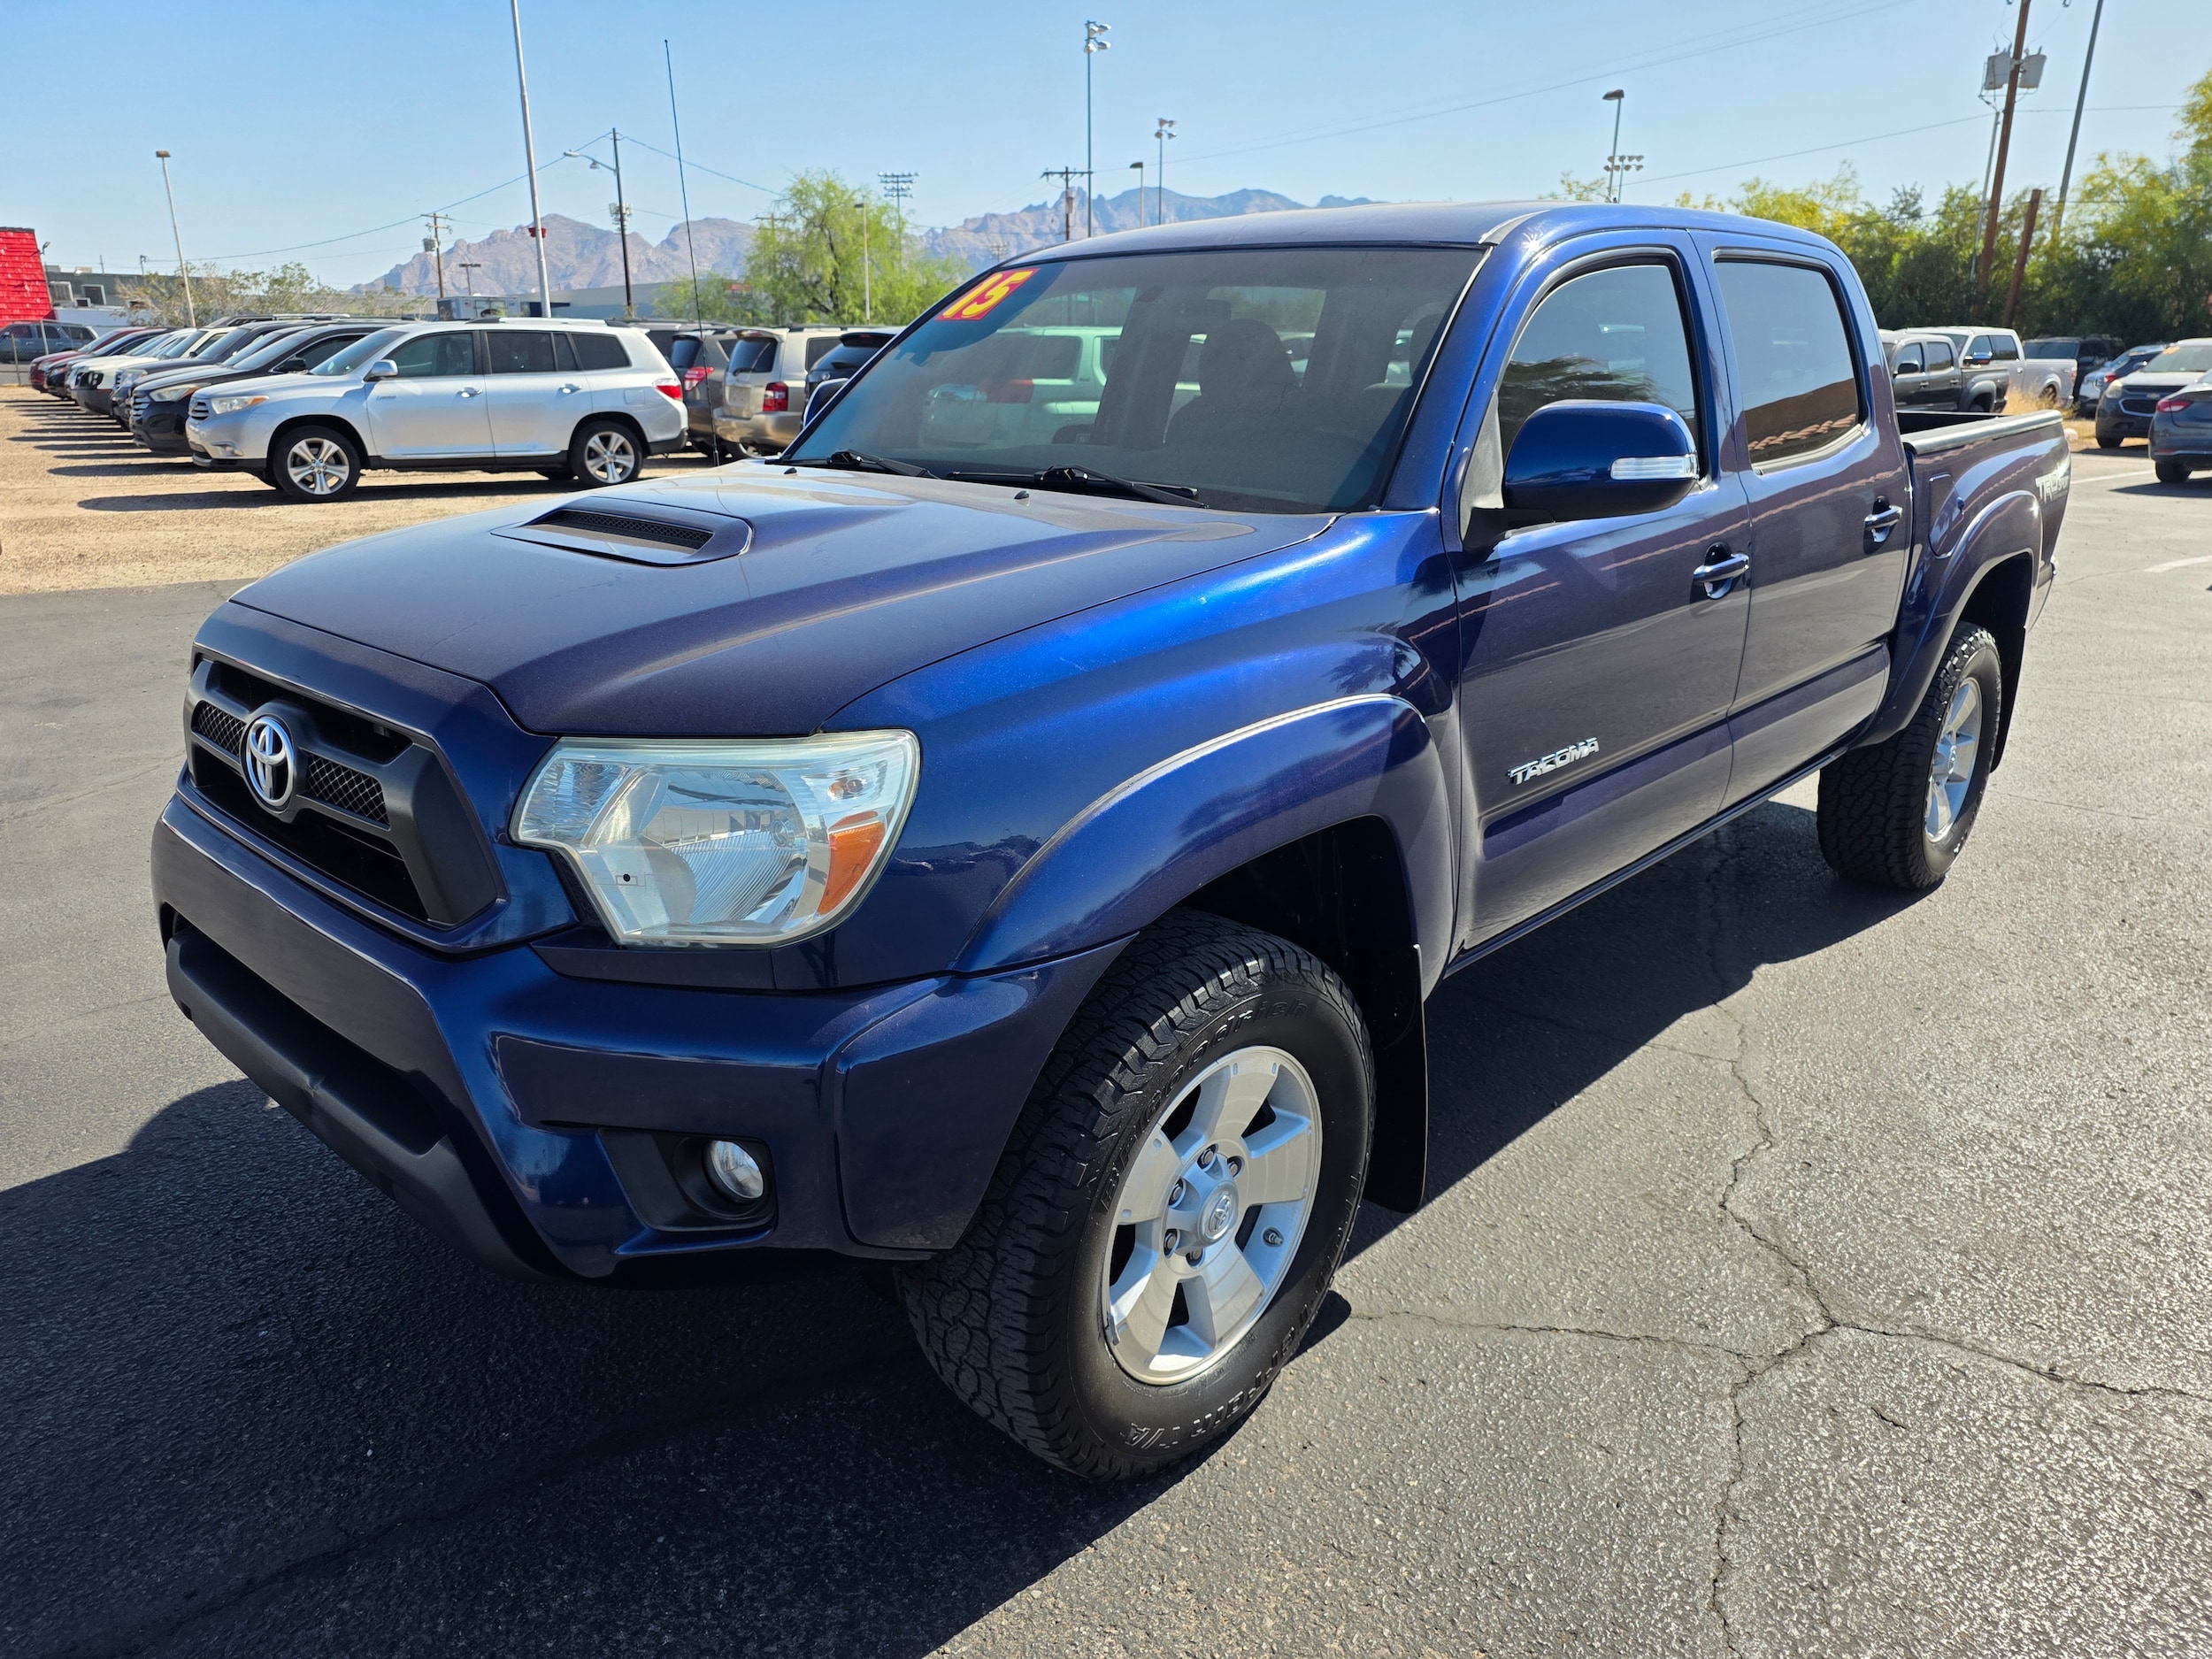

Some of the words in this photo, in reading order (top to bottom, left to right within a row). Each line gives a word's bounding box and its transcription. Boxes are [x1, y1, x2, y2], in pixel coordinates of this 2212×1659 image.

[942, 270, 1033, 319] 15
[2035, 470, 2059, 504] TRD
[1508, 737, 1600, 785] TACOMA
